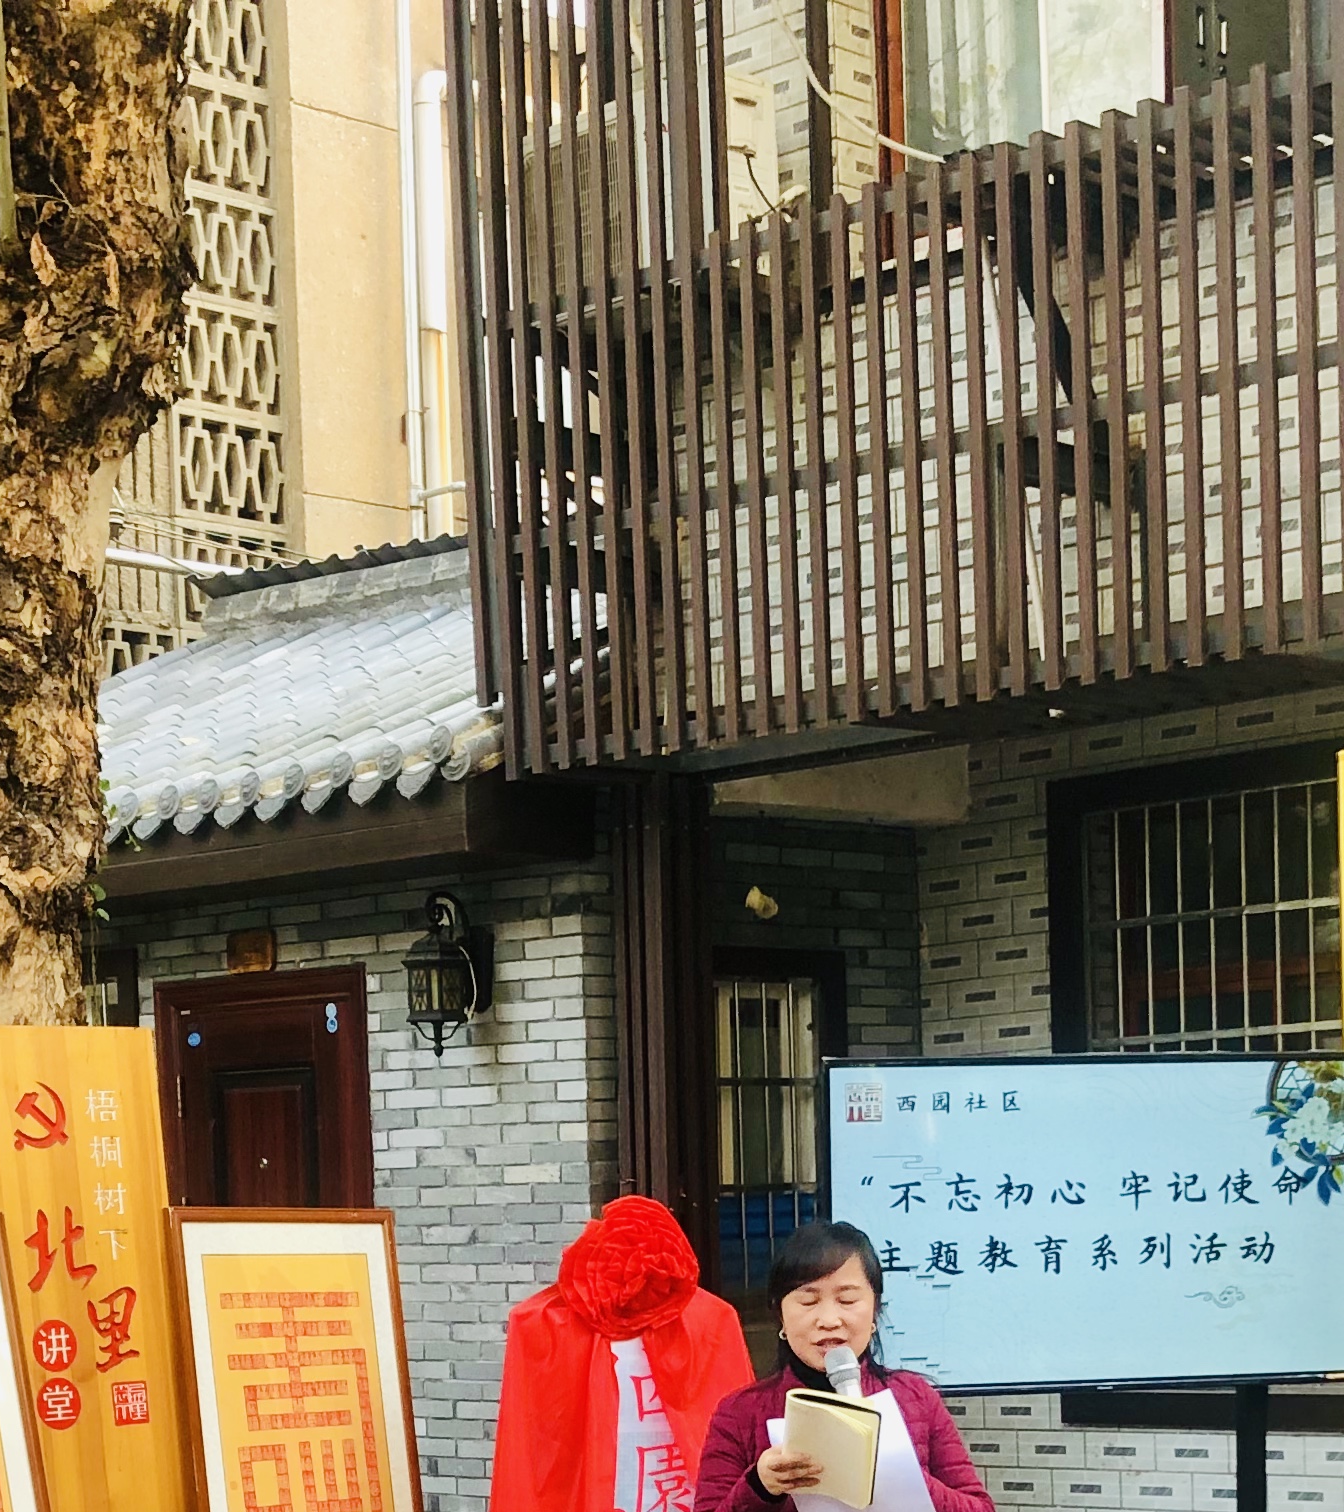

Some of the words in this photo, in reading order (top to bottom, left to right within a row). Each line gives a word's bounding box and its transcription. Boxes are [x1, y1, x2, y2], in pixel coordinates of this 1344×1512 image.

[895, 1090, 1022, 1115] 西园社区
[84, 1088, 129, 1262] 梧桐树下
[881, 1232, 1277, 1276] 主题教育系列活动
[36, 1324, 78, 1424] 讲堂
